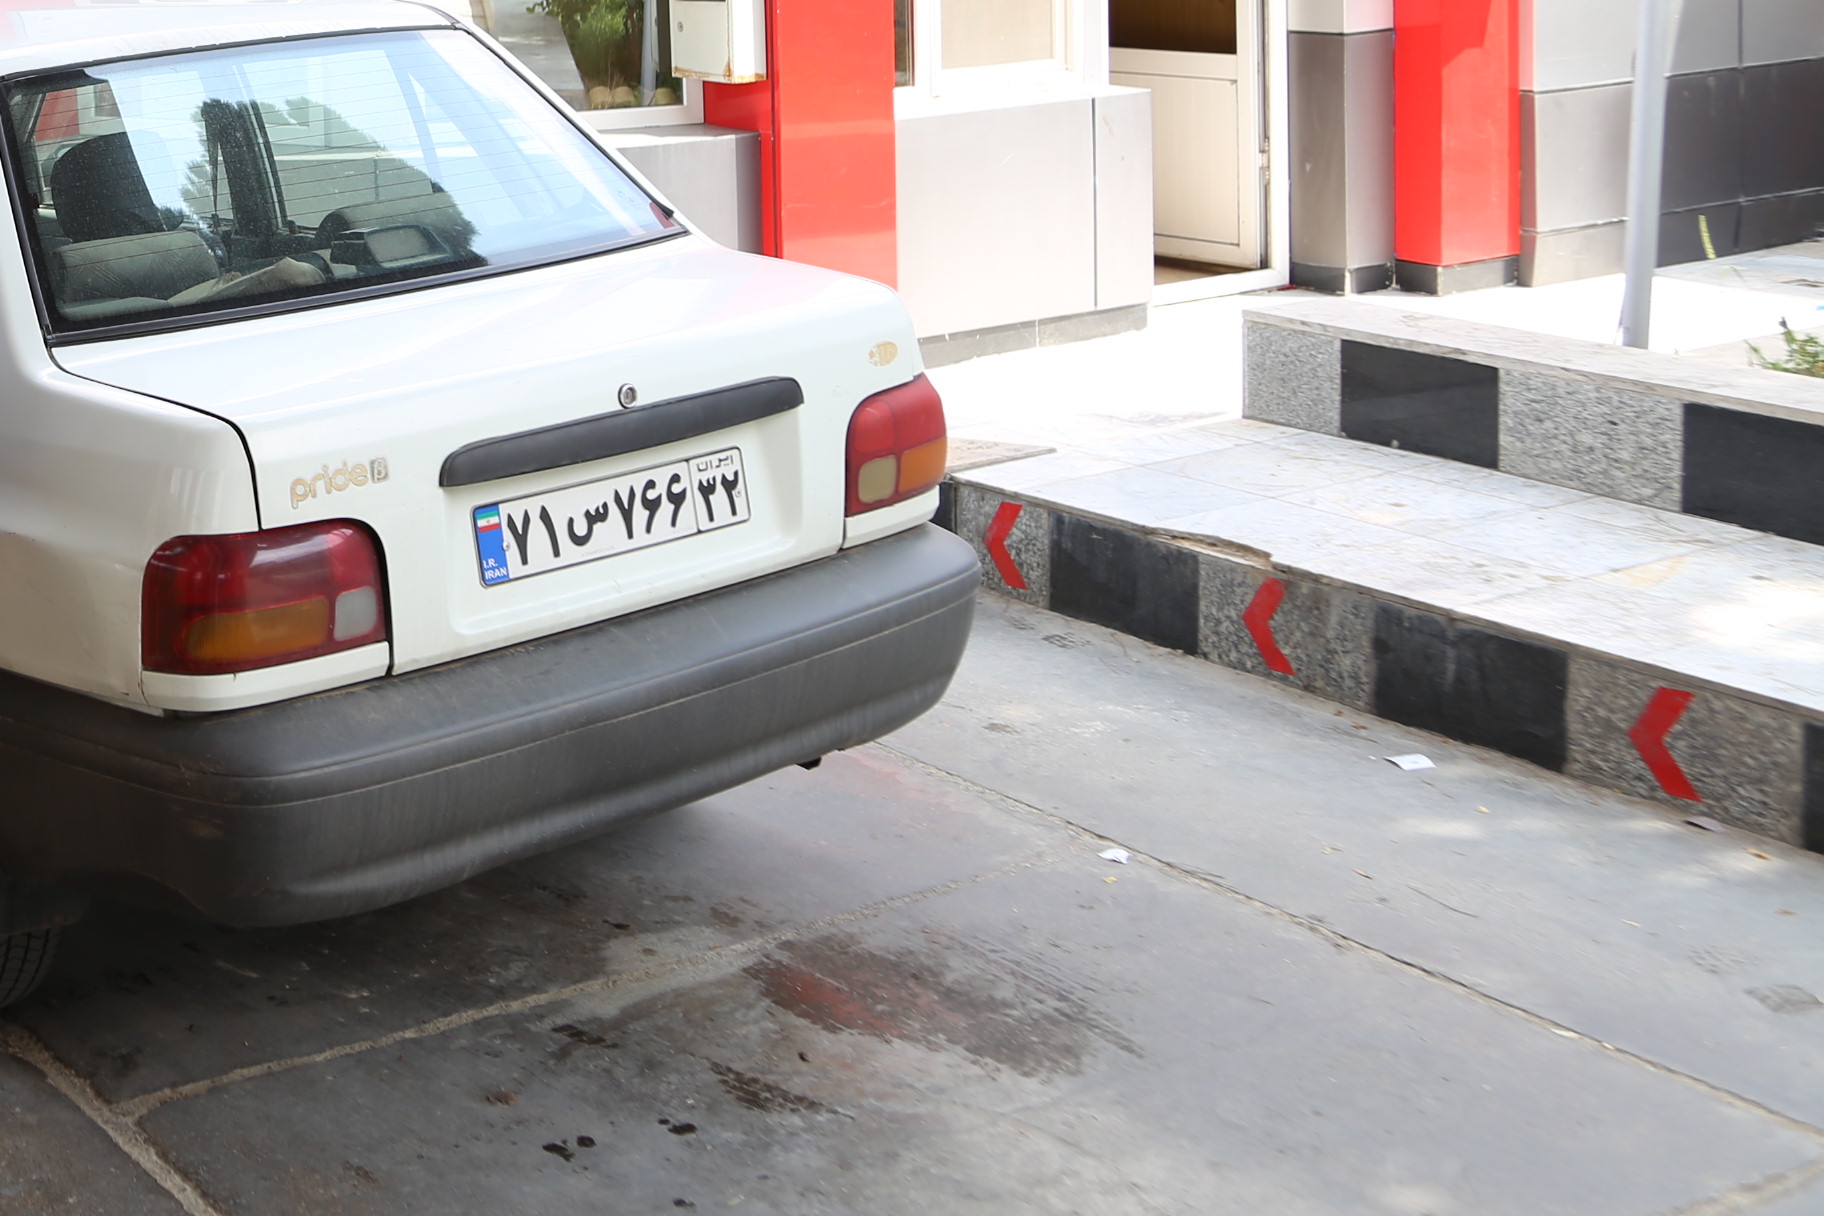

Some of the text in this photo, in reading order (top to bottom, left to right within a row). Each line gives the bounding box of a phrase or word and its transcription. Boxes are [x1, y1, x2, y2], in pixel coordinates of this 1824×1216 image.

[695, 454, 735, 473] ایران
[289, 460, 370, 510] pride
[483, 559, 499, 569] I.R.
[484, 567, 508, 581] IRAN
